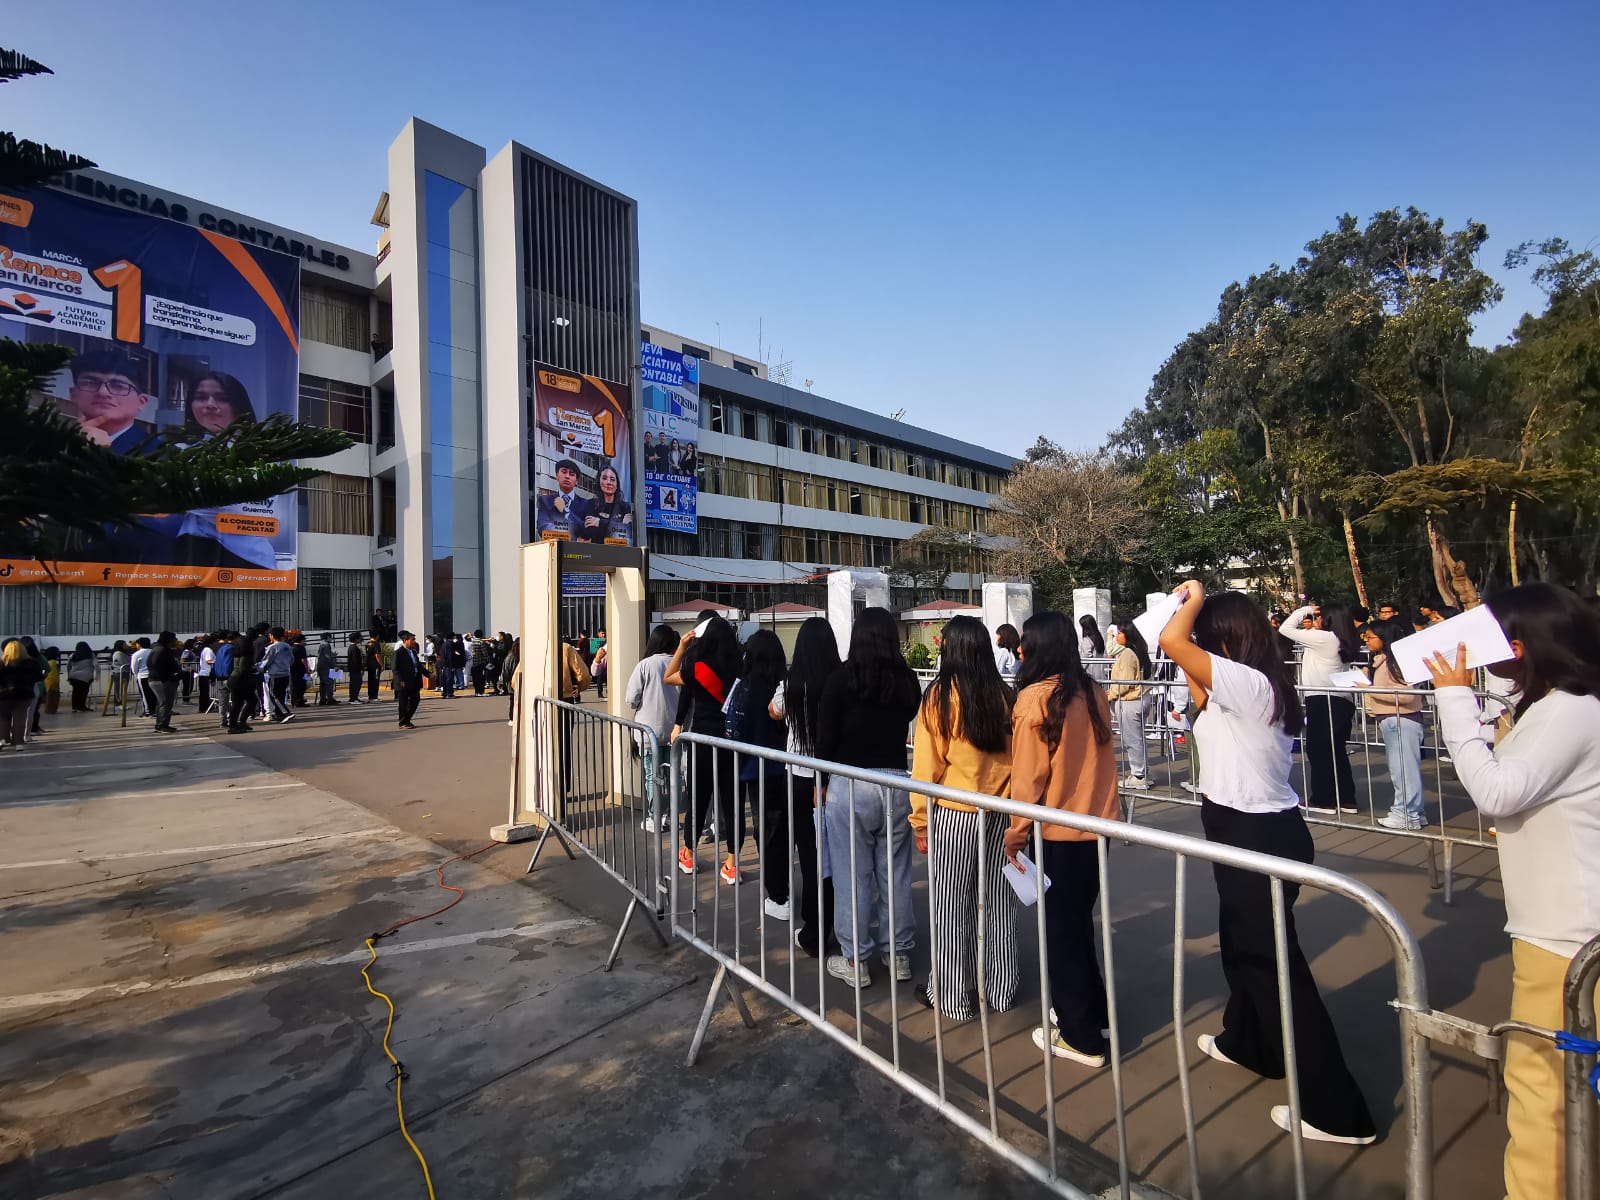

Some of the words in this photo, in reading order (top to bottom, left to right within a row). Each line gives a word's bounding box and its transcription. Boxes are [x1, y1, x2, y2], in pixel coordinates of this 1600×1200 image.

[199, 213, 350, 271] CONTABLES
[43, 249, 82, 265] MARCA:
[22, 273, 83, 295] Marcos
[91, 258, 142, 344] 1
[65, 305, 98, 318] FUTURO
[60, 318, 103, 332] CONTABLE
[152, 314, 207, 332] compromiso
[207, 328, 223, 336] que
[642, 355, 682, 374] ICIATIVA
[545, 374, 557, 386] 18
[593, 408, 616, 457] 1
[230, 518, 265, 527] CONSEJO
[237, 525, 275, 533] FACULTAD
[19, 569, 85, 578] @rencesm1
